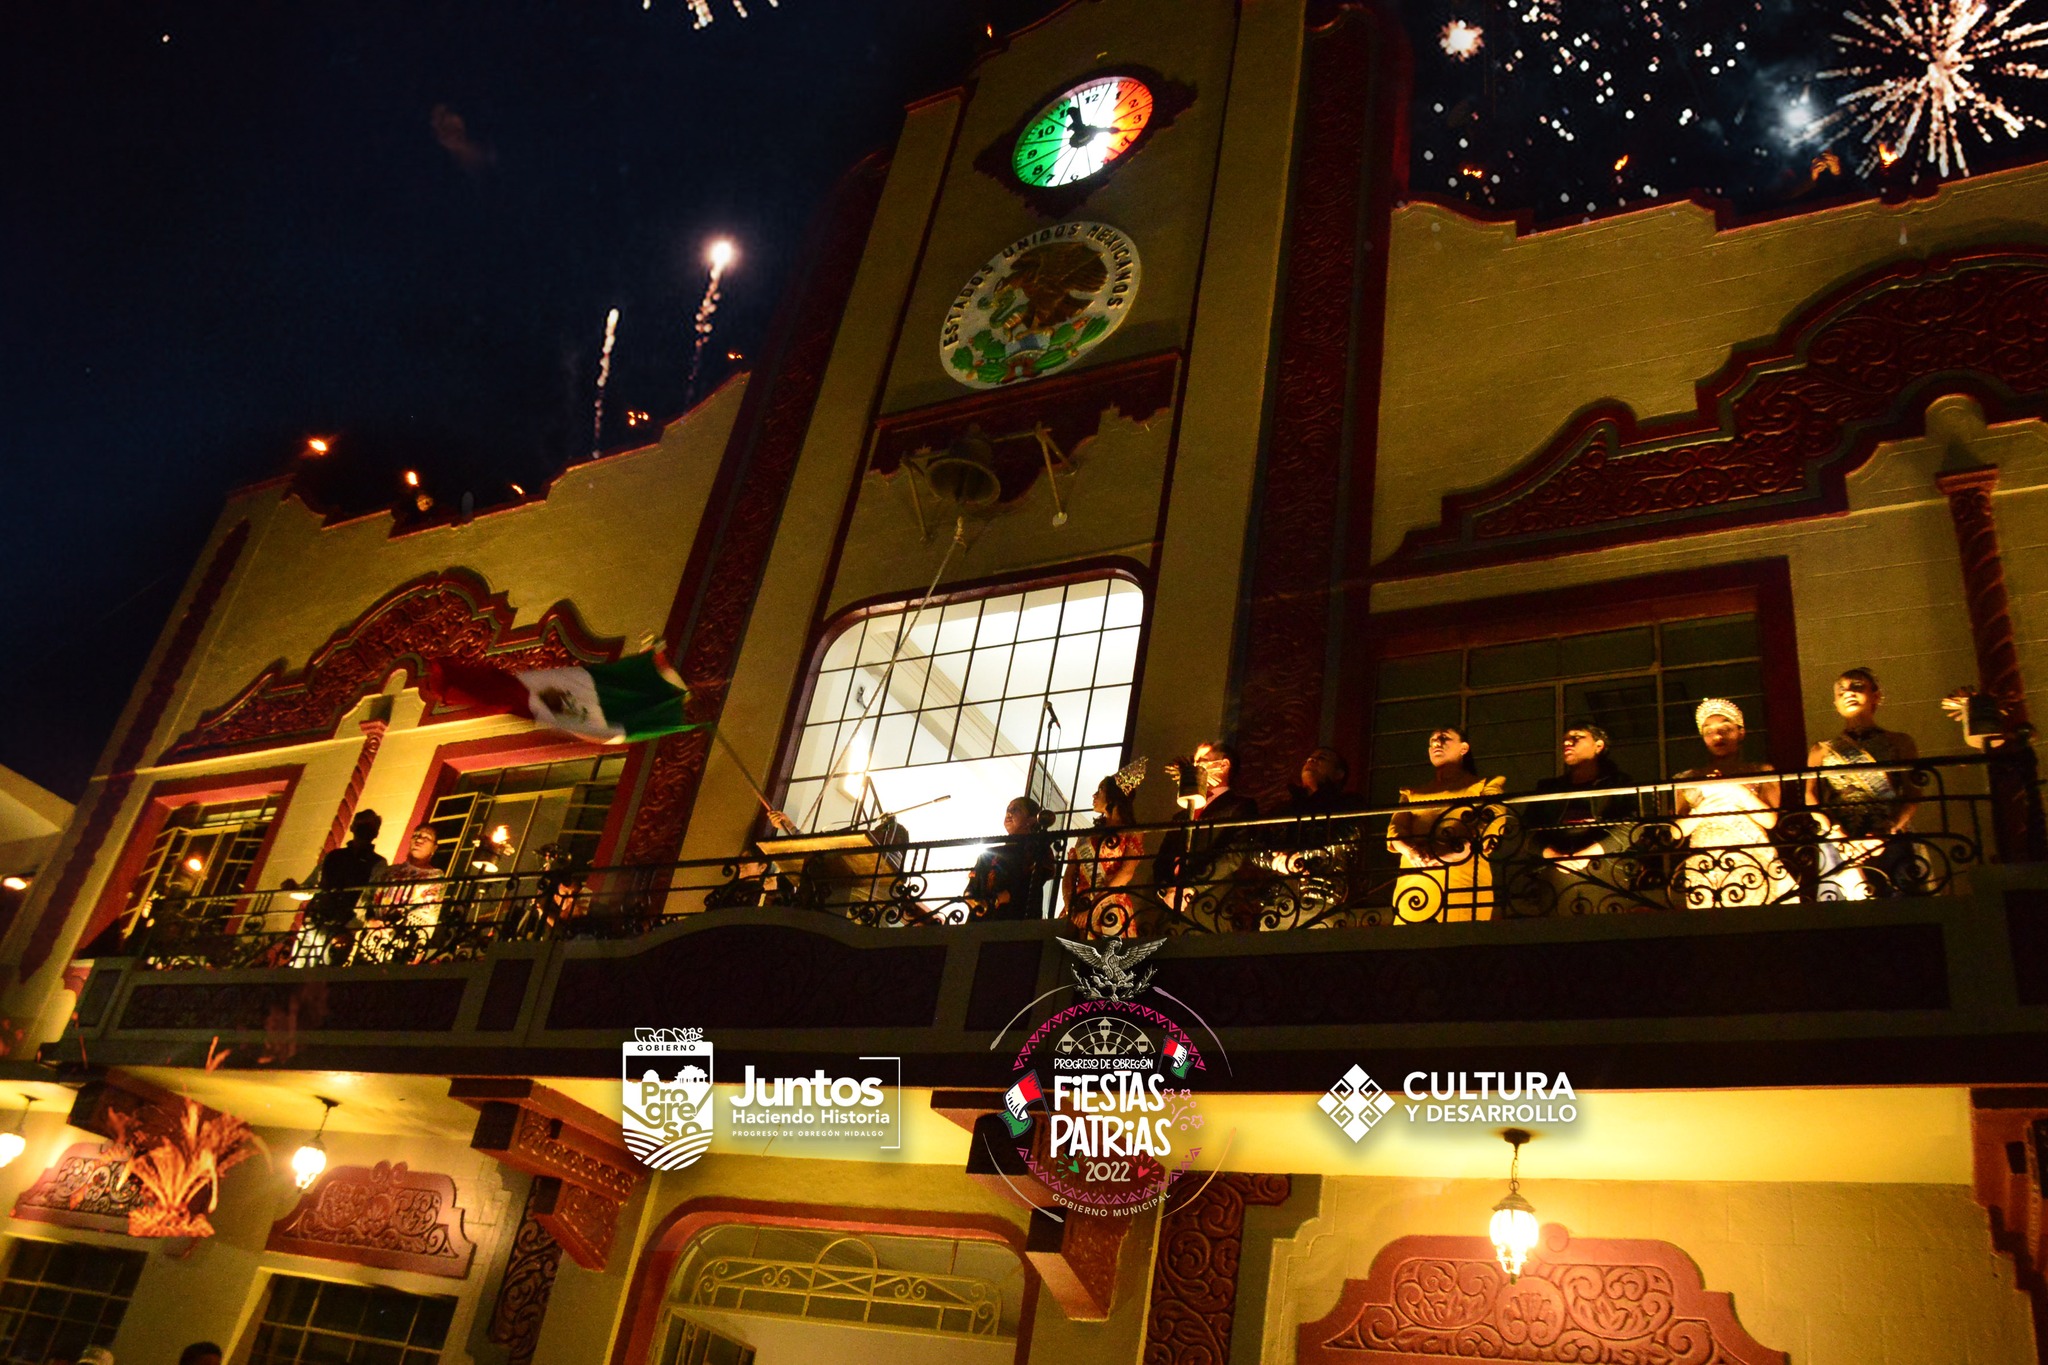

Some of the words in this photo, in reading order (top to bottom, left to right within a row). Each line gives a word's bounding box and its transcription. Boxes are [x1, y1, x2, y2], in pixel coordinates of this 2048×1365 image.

[1085, 93, 1100, 105] 12
[1128, 99, 1139, 109] 2
[1133, 114, 1142, 124] 3
[1037, 125, 1055, 139] 10
[1120, 136, 1132, 147] 4
[1027, 149, 1037, 159] 9
[1032, 164, 1043, 176] 8
[1046, 174, 1055, 183] 7
[943, 264, 993, 349] ESTADOS
[1002, 223, 1082, 260] UNIDOS
[1086, 224, 1134, 310] MEXICANOS
